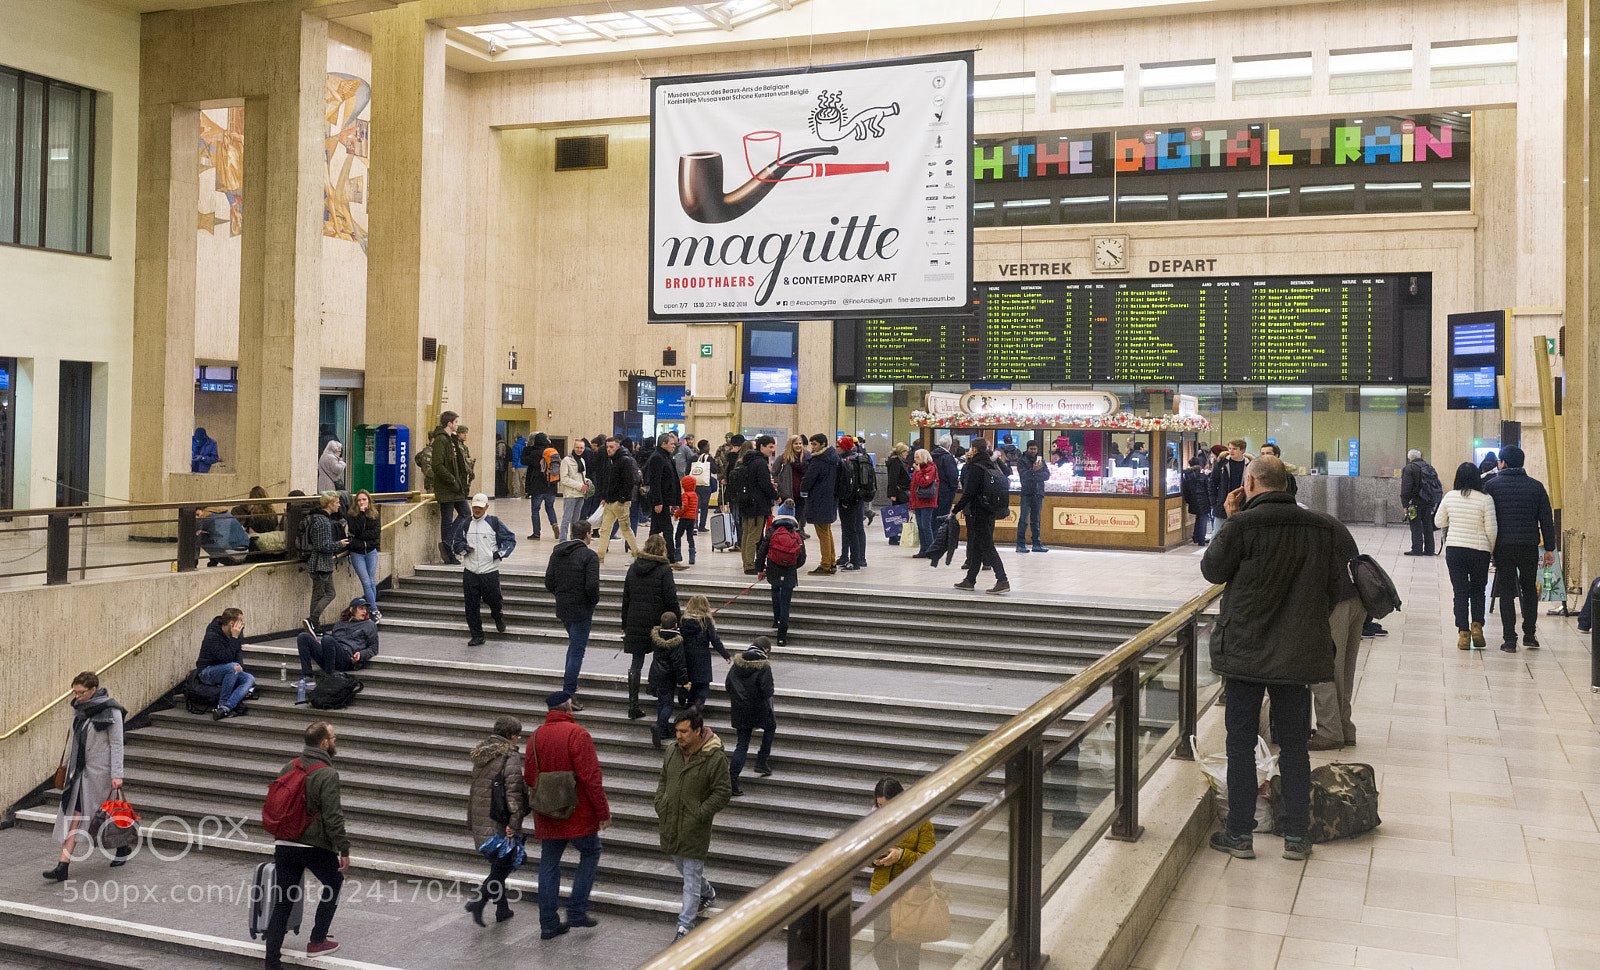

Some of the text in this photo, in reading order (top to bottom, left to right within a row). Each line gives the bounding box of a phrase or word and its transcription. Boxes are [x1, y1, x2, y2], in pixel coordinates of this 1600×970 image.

[1011, 140, 1092, 177] THE
[662, 214, 900, 306] magritte
[998, 259, 1217, 276] VERTREK DEPART
[666, 273, 897, 289] BROODTHAERS & CONTEMPORARY ART
[654, 369, 686, 378] CENTRE
